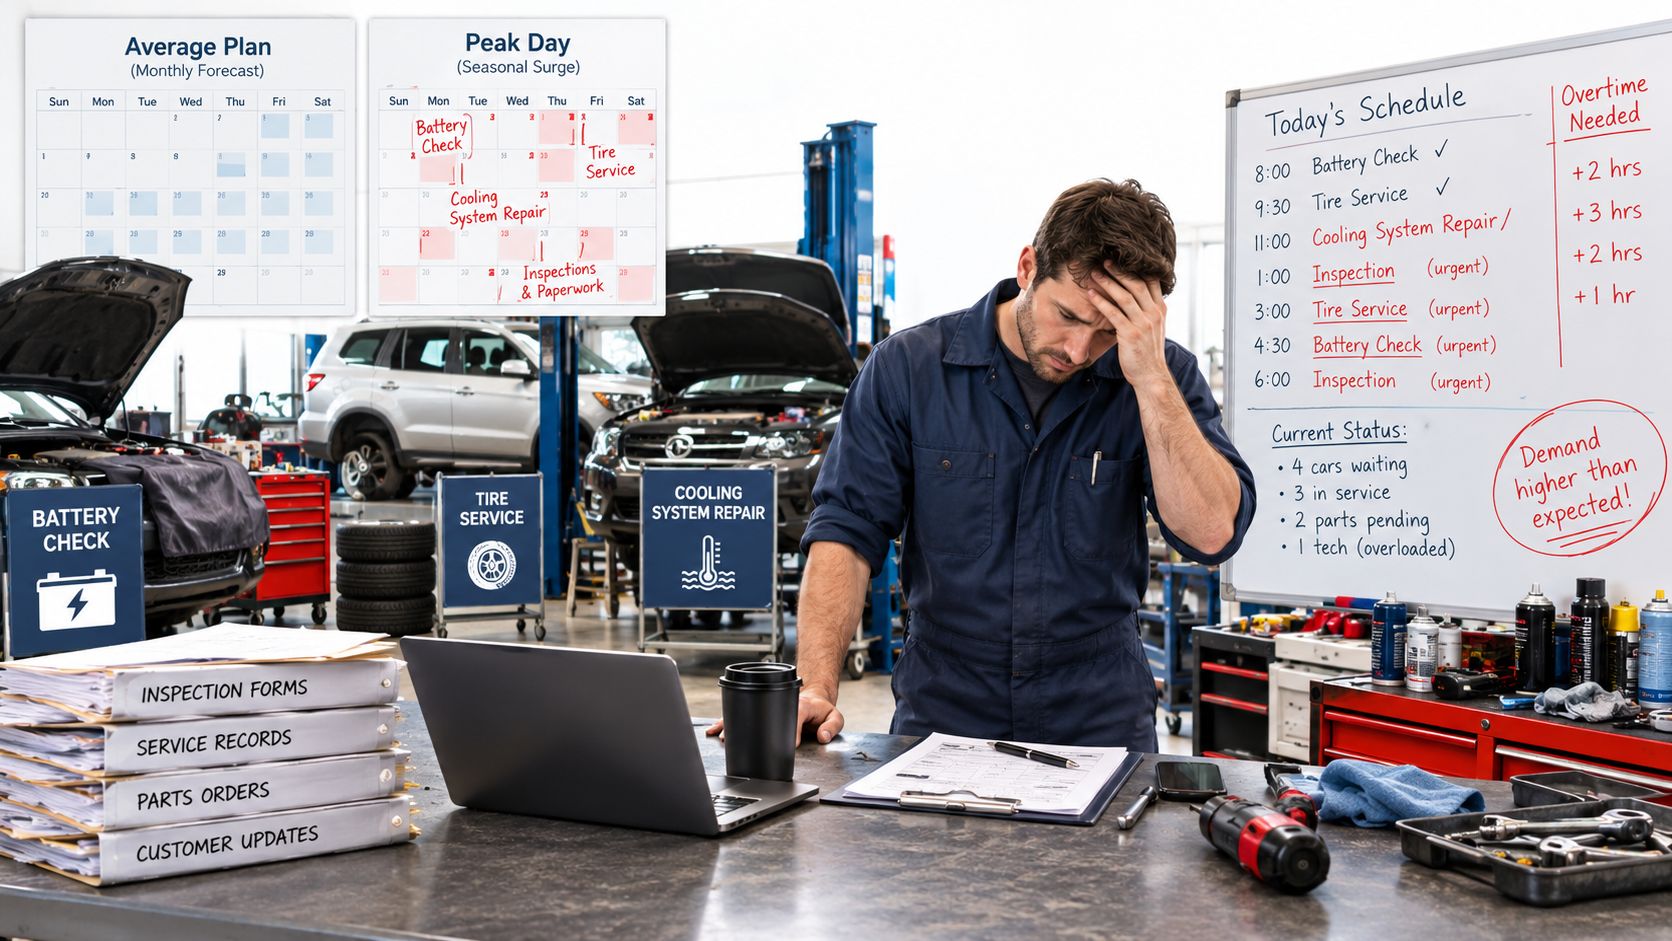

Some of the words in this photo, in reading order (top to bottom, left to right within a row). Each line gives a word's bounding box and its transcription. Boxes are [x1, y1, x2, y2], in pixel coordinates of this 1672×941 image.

[125, 37, 216, 60] Average
[225, 37, 271, 55] Plan
[467, 32, 520, 52] Peak
[529, 33, 570, 57] Day
[131, 64, 193, 80] (Monthly
[199, 64, 264, 79] Forecast)
[458, 60, 527, 75] (Seasonal
[533, 60, 580, 77] Surge)
[50, 97, 69, 106] Sun
[93, 97, 114, 106] Mon
[138, 97, 157, 106] Tue
[180, 97, 202, 106] Wed
[226, 97, 244, 106] Thu
[273, 97, 285, 106] Fri
[315, 97, 331, 106] Sat
[390, 96, 408, 105] Sun
[428, 96, 449, 105] Mon
[469, 96, 487, 106] Tue
[506, 96, 528, 105] Wed
[548, 96, 566, 105] Thu
[591, 96, 603, 105] Fri
[628, 96, 644, 106] Sat
[1561, 76, 1648, 106] Overtime
[1265, 102, 1346, 138] Today's
[1360, 82, 1467, 121] Schedule
[1570, 100, 1641, 132] Needed
[416, 119, 467, 137] Battery
[422, 137, 463, 154] Check
[588, 145, 616, 160] Tire
[586, 162, 636, 179] Service
[1255, 162, 1291, 183] 8:00
[1312, 151, 1367, 176] Battery
[1373, 144, 1420, 167] Check
[1573, 160, 1602, 181] +2
[1610, 157, 1643, 179] hrs
[451, 190, 498, 209] Cooling
[1255, 198, 1291, 218] 9:30
[1312, 191, 1342, 212] Tire
[1351, 186, 1409, 208] Service
[449, 207, 497, 230] System
[503, 205, 547, 225] Repair
[1573, 202, 1602, 223] +3
[1610, 200, 1643, 220] hrs
[1254, 233, 1291, 252] 11:00
[1312, 225, 1367, 250] Cooling
[1376, 220, 1434, 247] System
[1573, 244, 1602, 264] +2
[1610, 242, 1643, 263] hrs
[523, 262, 596, 283] Inspections
[1257, 268, 1291, 287] 1:00
[1312, 263, 1396, 288] Inspection
[1427, 256, 1490, 279] (urgent)
[521, 285, 532, 301] &
[537, 279, 605, 300] Paperwork
[1574, 286, 1599, 305] +1
[1613, 284, 1636, 304] hr
[1255, 303, 1291, 321] 3:00
[1312, 300, 1344, 318] Tire
[1351, 300, 1408, 317] Service
[1254, 336, 1291, 355] 4:30
[1312, 336, 1369, 359] Battery
[1376, 334, 1422, 352] Check
[1254, 370, 1291, 389] 6:00
[1313, 372, 1396, 394] Inspection
[1430, 371, 1491, 394] (urgent)
[1272, 422, 1333, 444] Current
[1343, 421, 1408, 440] Status:
[1520, 426, 1602, 469] Demand
[1291, 458, 1304, 476] 4
[1311, 459, 1341, 475] cars
[1351, 457, 1408, 479] waiting
[1515, 470, 1576, 505] higher
[1586, 454, 1638, 483] than
[476, 492, 508, 505] TIRE
[675, 486, 742, 500] COOLING
[1294, 484, 1305, 502] 3
[1313, 486, 1327, 501] in
[1336, 483, 1391, 501] service
[33, 507, 120, 527] BATTERY
[460, 510, 524, 525] SERVICE
[652, 506, 709, 519] SYSTEM
[715, 506, 765, 519] REPAIR
[1532, 482, 1633, 531] expected!
[1295, 511, 1306, 528] 2
[1315, 512, 1358, 536] parts
[1367, 510, 1430, 535] pending
[44, 532, 110, 552] CHECK
[1299, 538, 1303, 555] 1
[1313, 538, 1348, 556] tech
[1357, 536, 1456, 560] (overloaded)
[142, 682, 242, 703] INSPECTION
[251, 679, 307, 697] FORMS
[137, 736, 207, 756] SERVICE
[215, 729, 291, 750] RECORDS
[138, 790, 192, 810] PARTS
[202, 782, 269, 803] ORDERS
[137, 836, 233, 862] CUSTOMER
[242, 825, 318, 849] UPDATES
